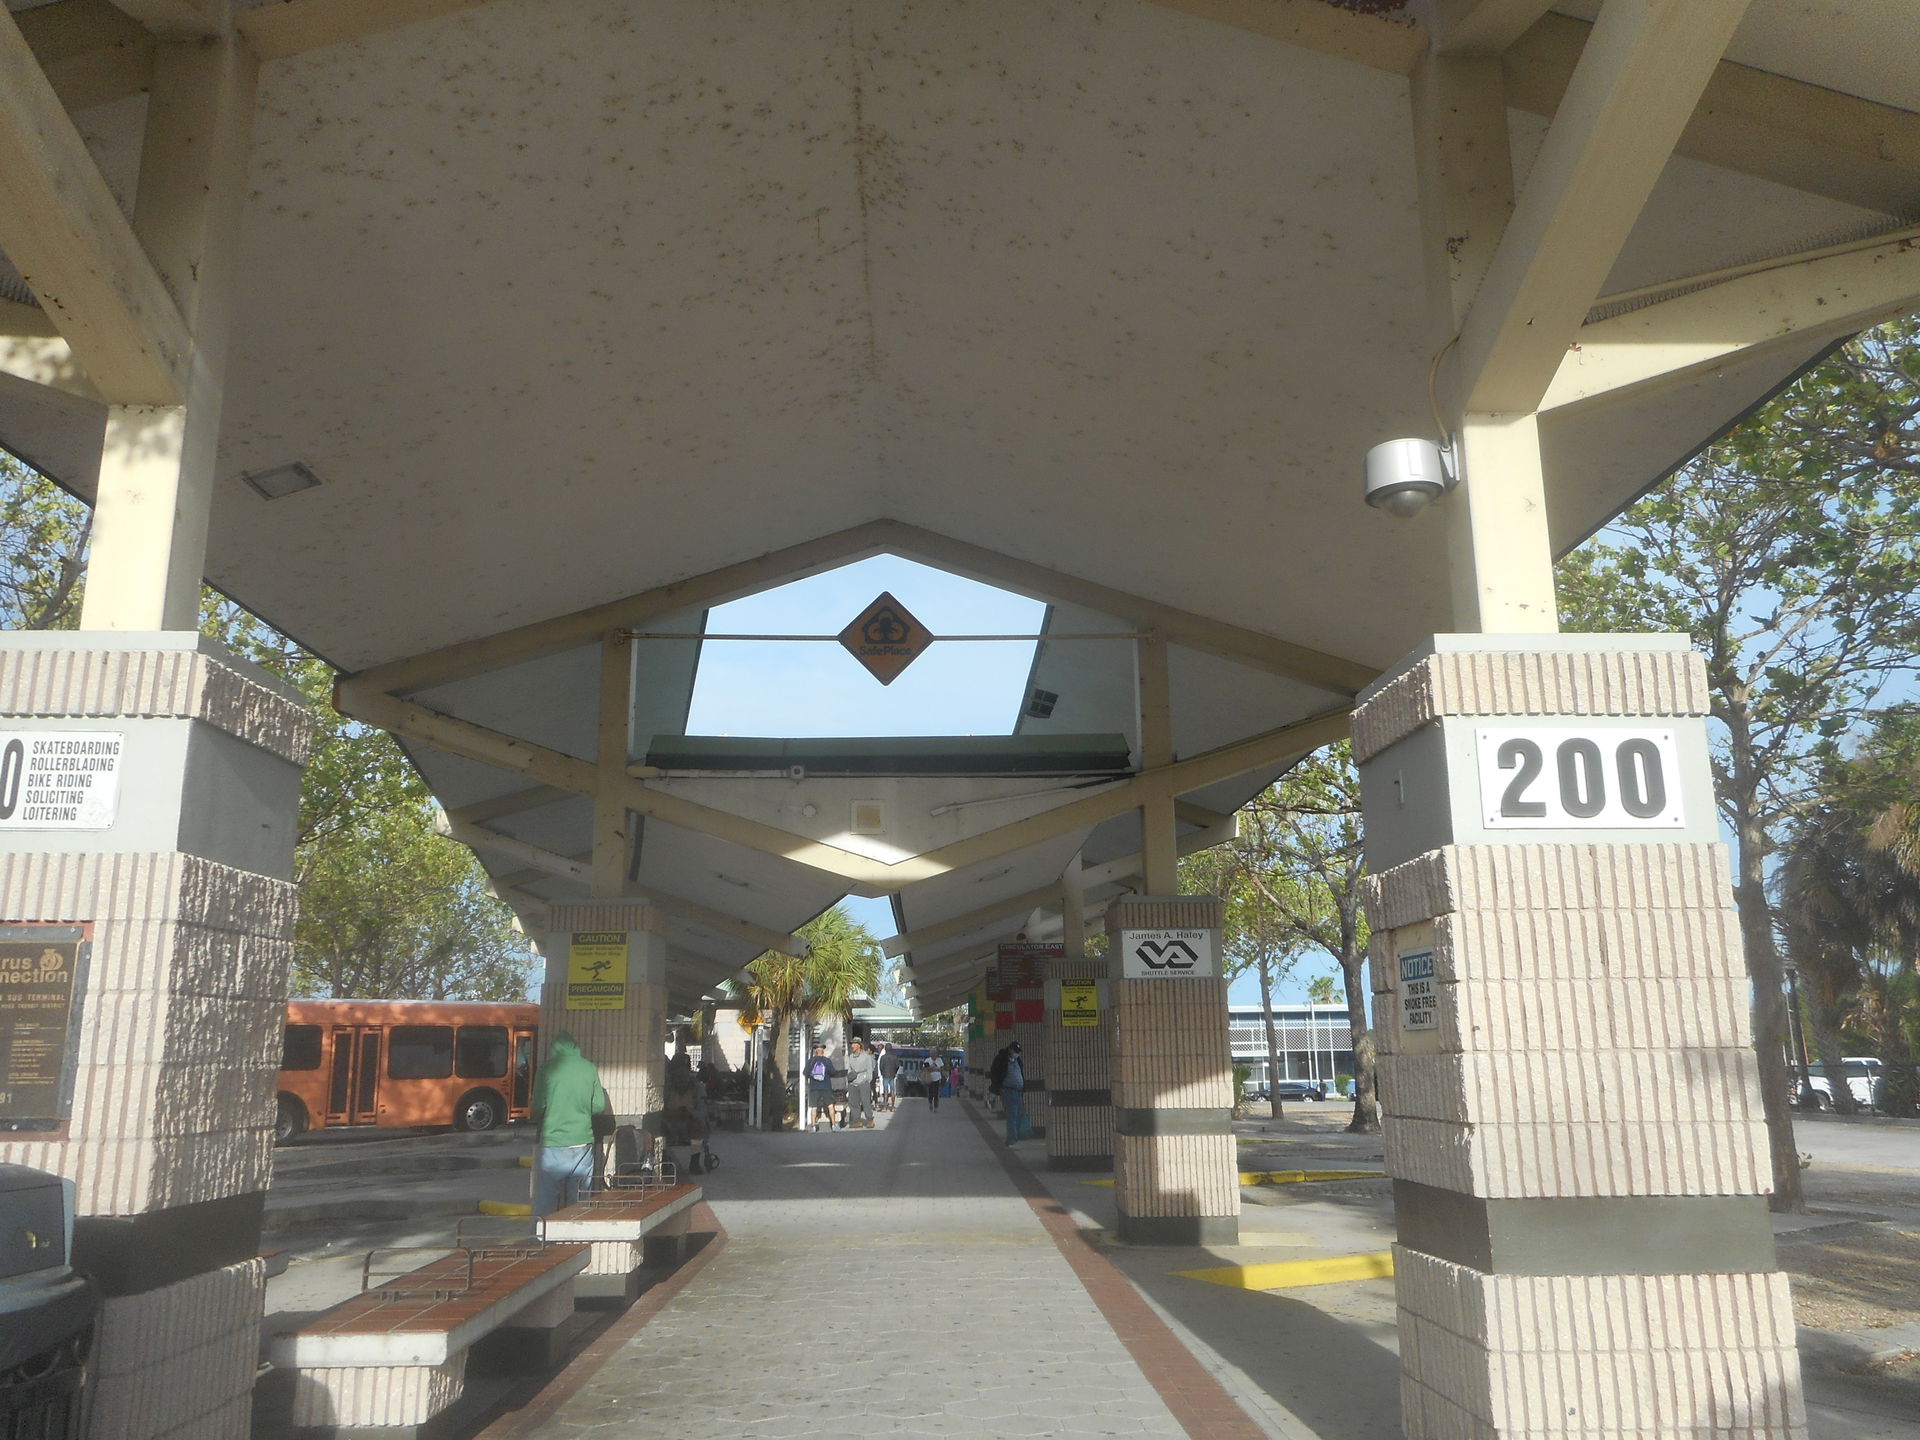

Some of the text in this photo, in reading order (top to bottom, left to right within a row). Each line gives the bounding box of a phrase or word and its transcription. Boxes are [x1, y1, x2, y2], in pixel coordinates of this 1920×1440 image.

[33, 741, 120, 755] SKATEBOARDING
[30, 757, 114, 771] ROLLERBLADING
[28, 774, 93, 788] BIKE RIDING
[1497, 737, 1667, 819] 200
[25, 790, 84, 804] SOLICITING
[22, 807, 77, 821] LOITERING
[579, 934, 621, 943] CAUTION
[1163, 931, 1174, 939] A.
[1176, 931, 1204, 940] Haley
[1401, 956, 1433, 979] NOTICE
[1408, 981, 1430, 995] THIS IS A
[1404, 996, 1437, 1011] SMOKE FREE
[1409, 1011, 1433, 1025] FACILITY
